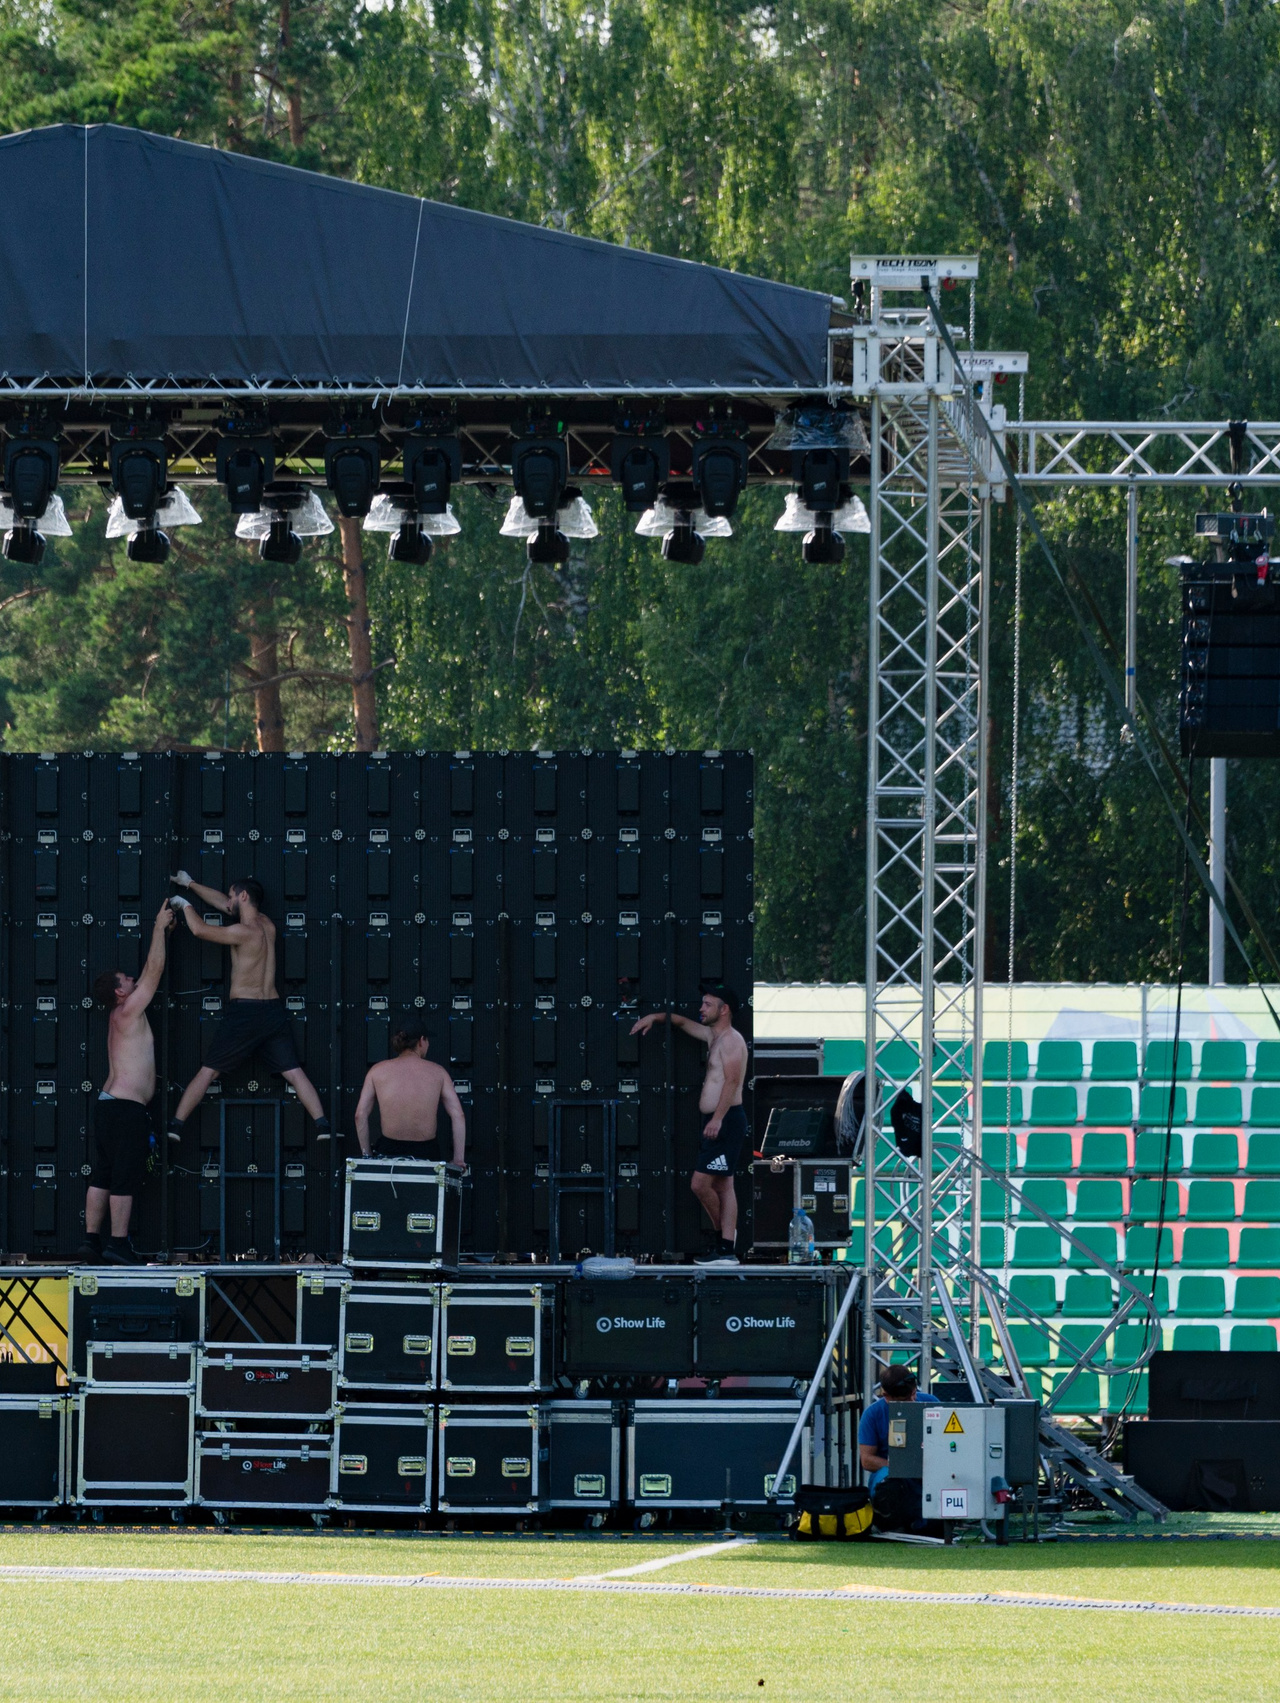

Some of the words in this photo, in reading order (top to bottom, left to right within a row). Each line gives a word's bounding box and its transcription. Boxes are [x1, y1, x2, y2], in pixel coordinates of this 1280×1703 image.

[876, 259, 905, 267] TECH
[778, 1138, 811, 1147] metabo
[613, 1316, 645, 1328] Show
[646, 1316, 666, 1328] Life
[743, 1316, 775, 1328] Show
[776, 1316, 796, 1328] Life
[275, 1371, 289, 1379] Life
[273, 1461, 286, 1469] Life
[946, 1497, 964, 1509] РЩ
